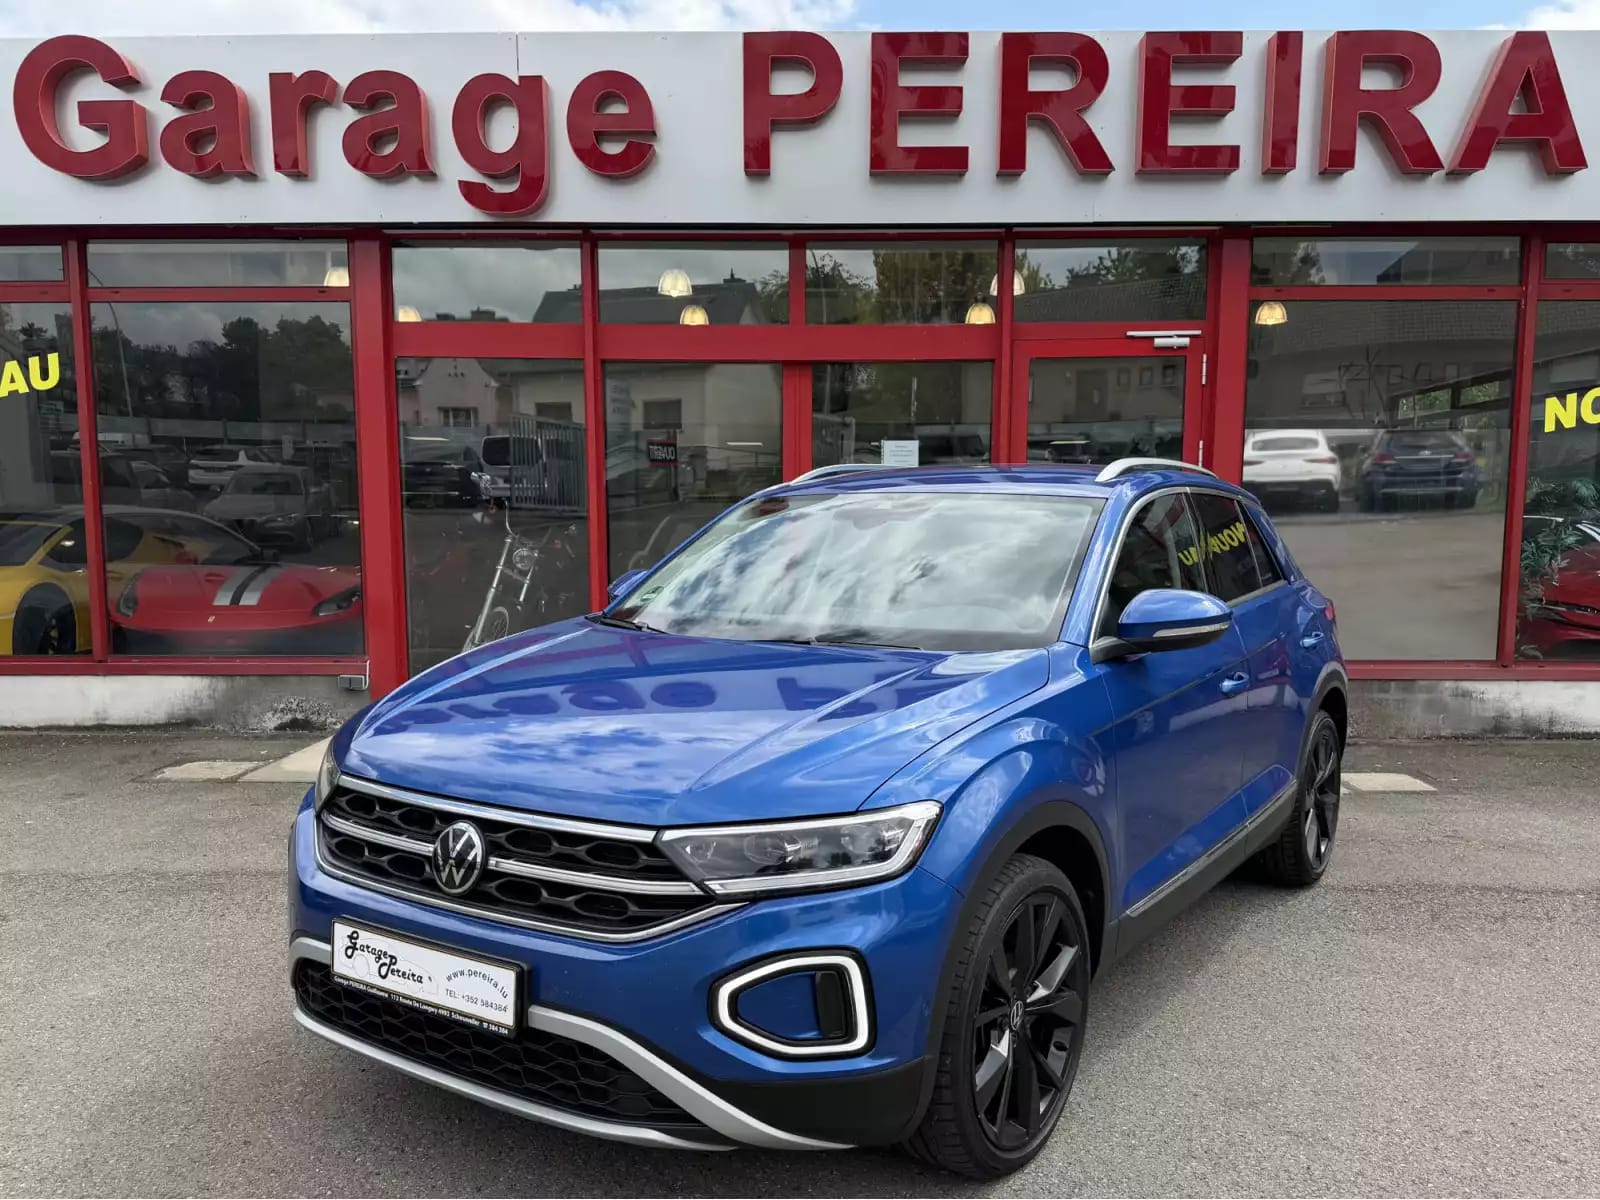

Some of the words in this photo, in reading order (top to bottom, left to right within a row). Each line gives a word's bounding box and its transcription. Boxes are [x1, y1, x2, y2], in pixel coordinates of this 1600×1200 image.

[13, 34, 657, 217] Garage
[742, 30, 1588, 176] PEREIRA
[0, 352, 59, 397] AU
[345, 930, 388, 963] Garage
[378, 954, 423, 984] Pereira
[446, 968, 509, 999] www.pereira.lu
[446, 988, 459, 999] TEL:
[462, 994, 478, 1005] +352
[480, 999, 508, 1013] 584384
